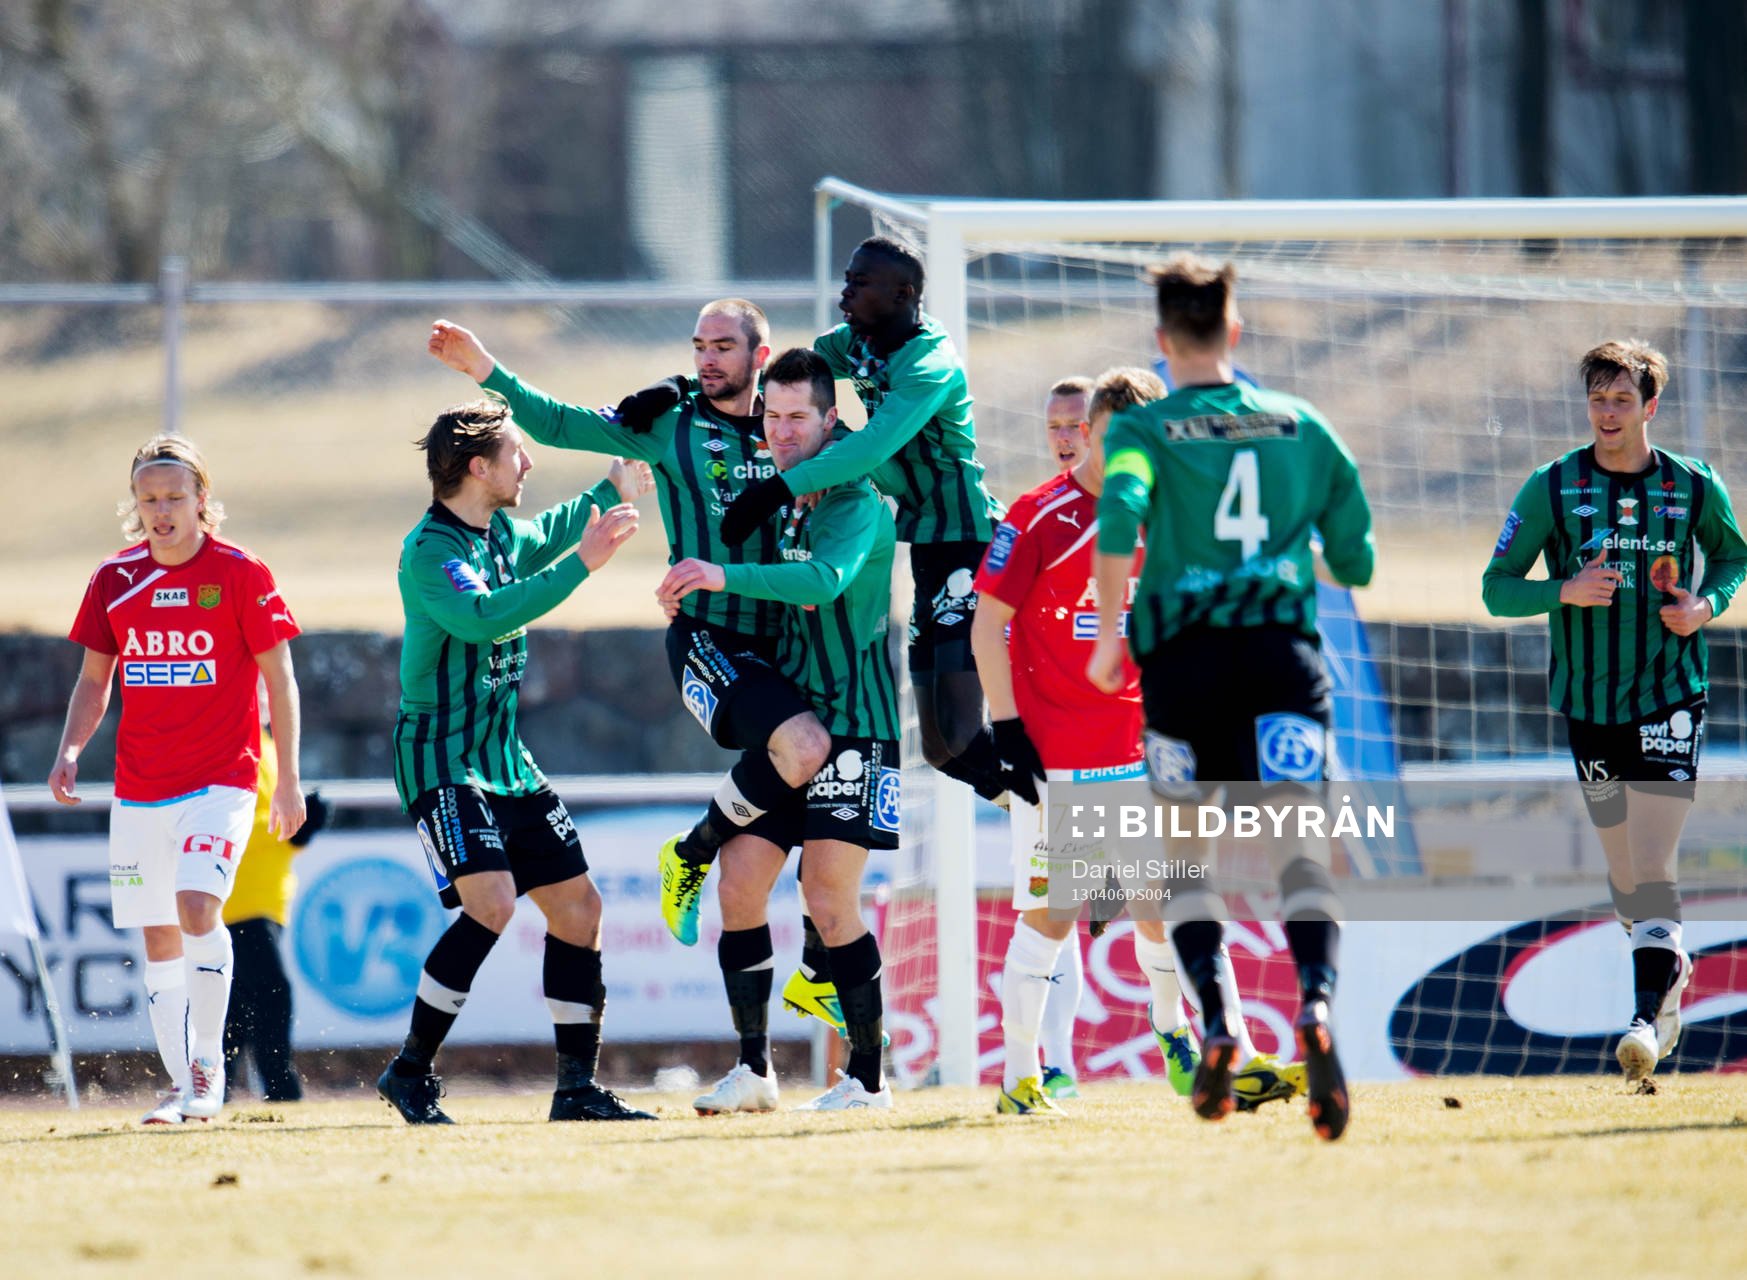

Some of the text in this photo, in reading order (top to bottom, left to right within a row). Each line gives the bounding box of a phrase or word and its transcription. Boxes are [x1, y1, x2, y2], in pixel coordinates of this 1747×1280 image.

[733, 461, 777, 480] cha
[1214, 449, 1270, 563] 4
[155, 591, 187, 602] SKAB
[123, 627, 214, 656] ÅBRO
[1641, 737, 1692, 756] paper
[809, 763, 835, 784] wt
[1579, 760, 1609, 782] VS
[807, 781, 864, 800] paper
[183, 834, 237, 864] GT
[450, 817, 468, 864] FORUM
[128, 876, 143, 887] AB
